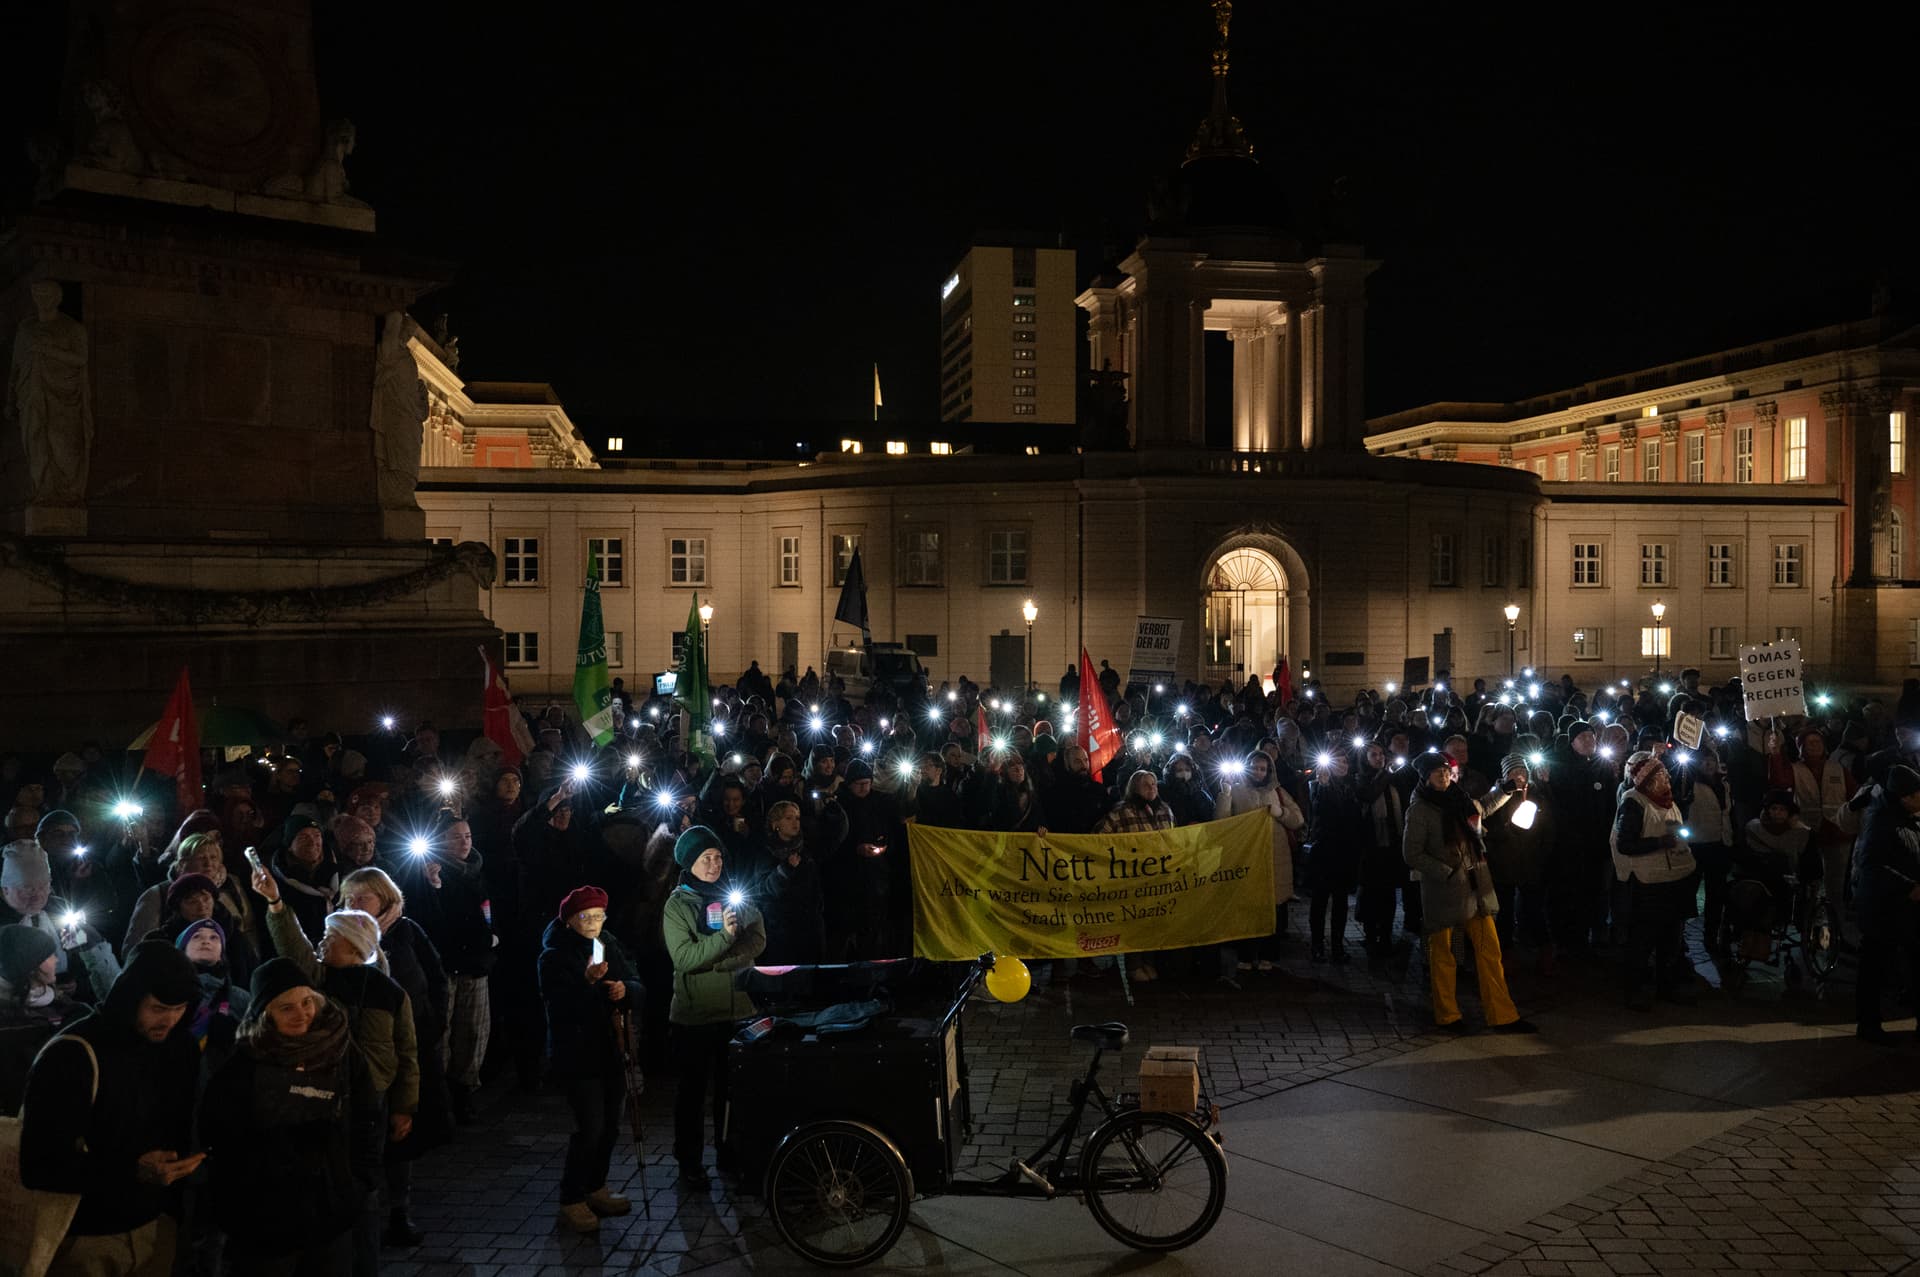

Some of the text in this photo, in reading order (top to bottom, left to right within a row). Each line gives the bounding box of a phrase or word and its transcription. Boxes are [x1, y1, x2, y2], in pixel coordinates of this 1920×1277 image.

[1139, 622, 1169, 636] VERBOT
[1136, 636, 1153, 649] DER
[1748, 650, 1791, 664] OMAS
[1747, 668, 1795, 683] GEGEN
[1746, 686, 1800, 701] RECHTS
[1018, 846, 1181, 882] Nett hier.
[939, 865, 1250, 904] Aber waren Sie schon einmal in einer
[1021, 897, 1177, 927] Stadt ohne Nazis?
